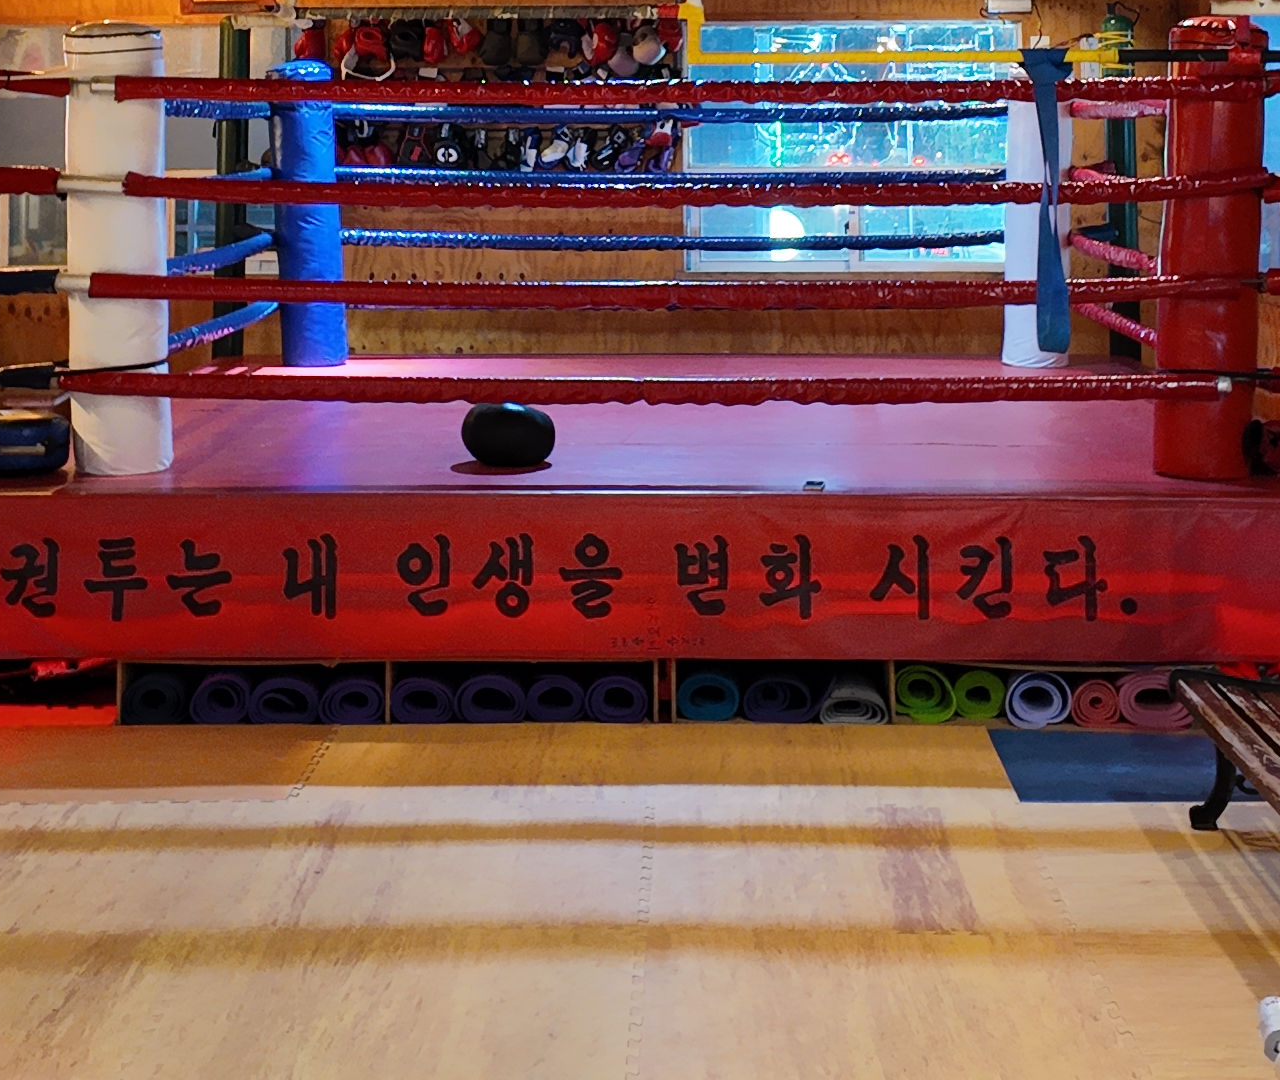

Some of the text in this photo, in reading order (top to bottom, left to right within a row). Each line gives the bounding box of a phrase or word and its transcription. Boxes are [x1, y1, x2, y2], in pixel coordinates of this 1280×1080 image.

[0, 532, 1139, 622] 권투는 내 인생을 변화 시킨다.
